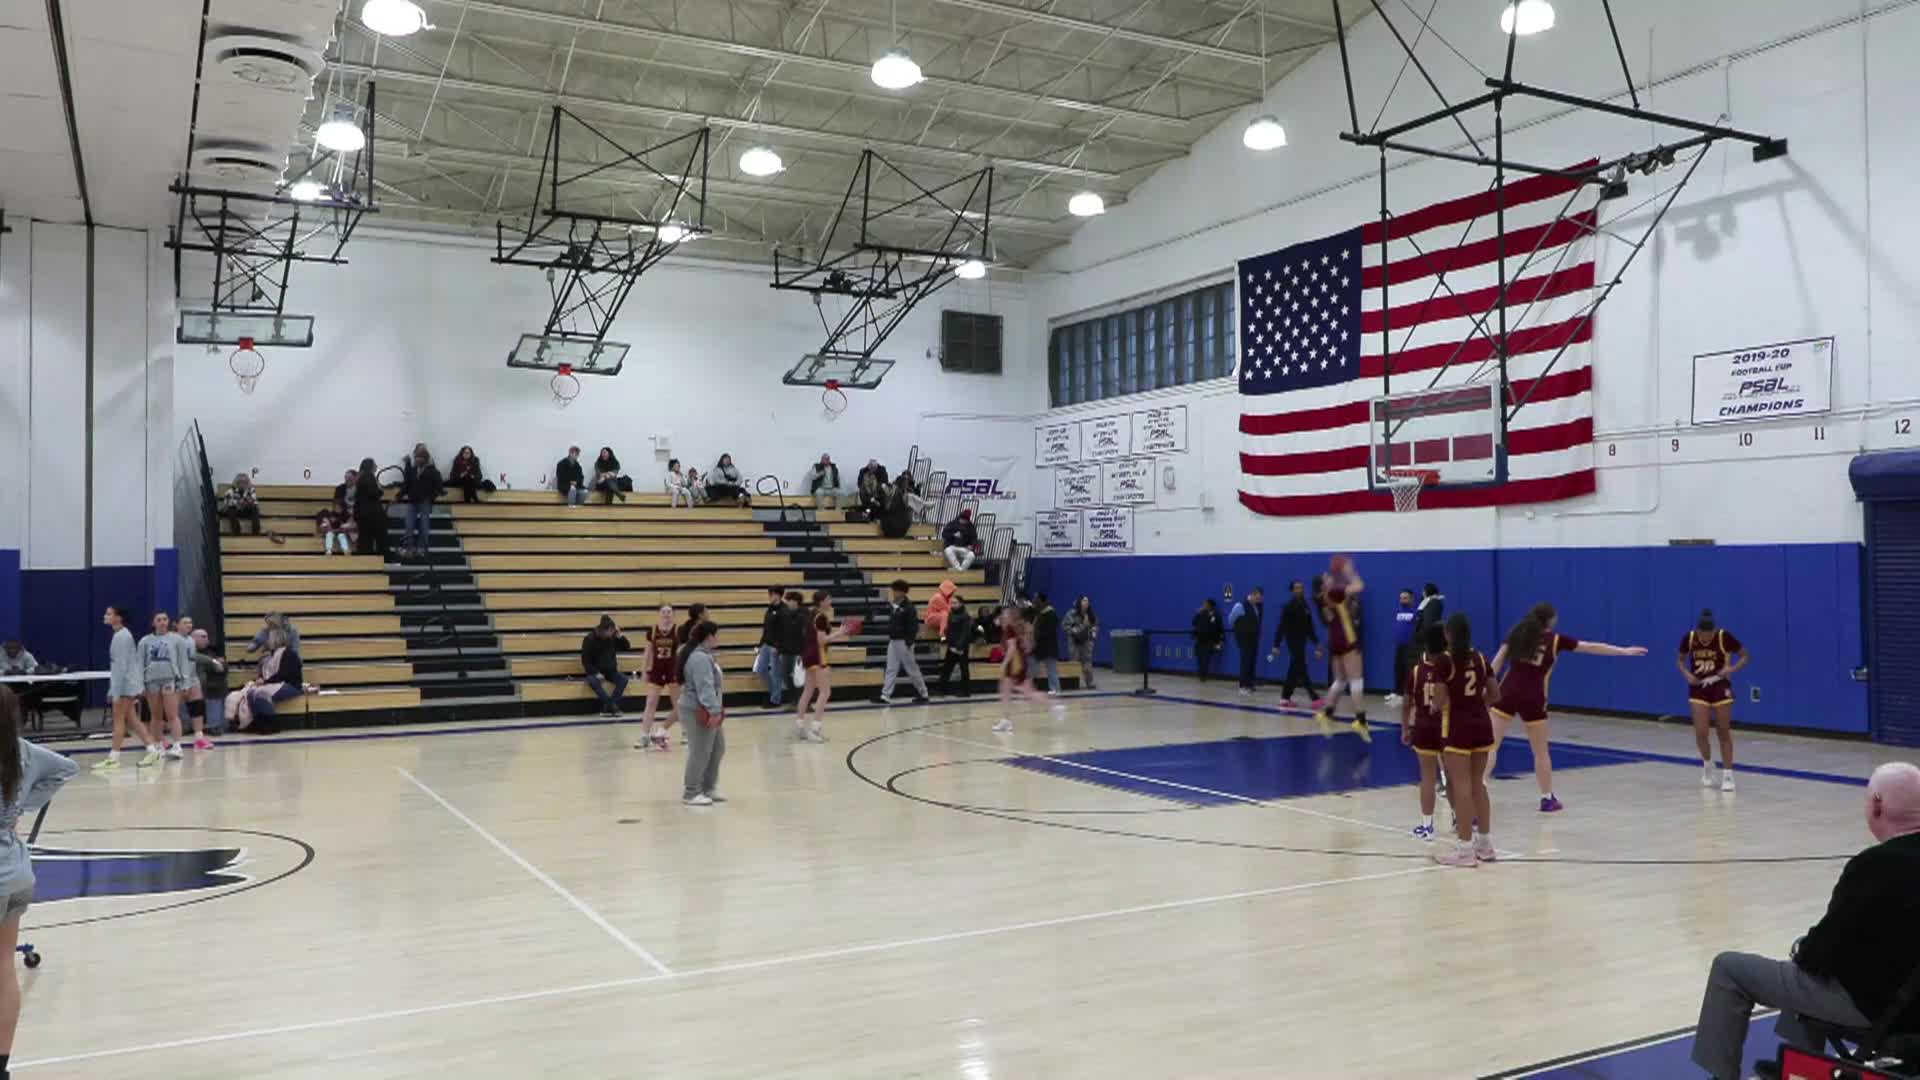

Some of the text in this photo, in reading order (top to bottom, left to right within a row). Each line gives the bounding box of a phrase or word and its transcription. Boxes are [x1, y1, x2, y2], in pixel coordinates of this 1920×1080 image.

[1732, 348, 1790, 364] 2019-20
[1731, 362, 1792, 377] FOOTBALL CUP
[1739, 377, 1788, 394] PSAL
[1719, 398, 1804, 417] CHAMPIONS
[1814, 426, 1825, 440] 11
[1895, 418, 1911, 434] 12
[1671, 439, 1680, 452] 9
[1739, 433, 1753, 447] 10
[1609, 444, 1617, 456] 8
[946, 479, 1003, 495] PSAL
[658, 647, 671, 658] 23
[1464, 670, 1477, 696] 2
